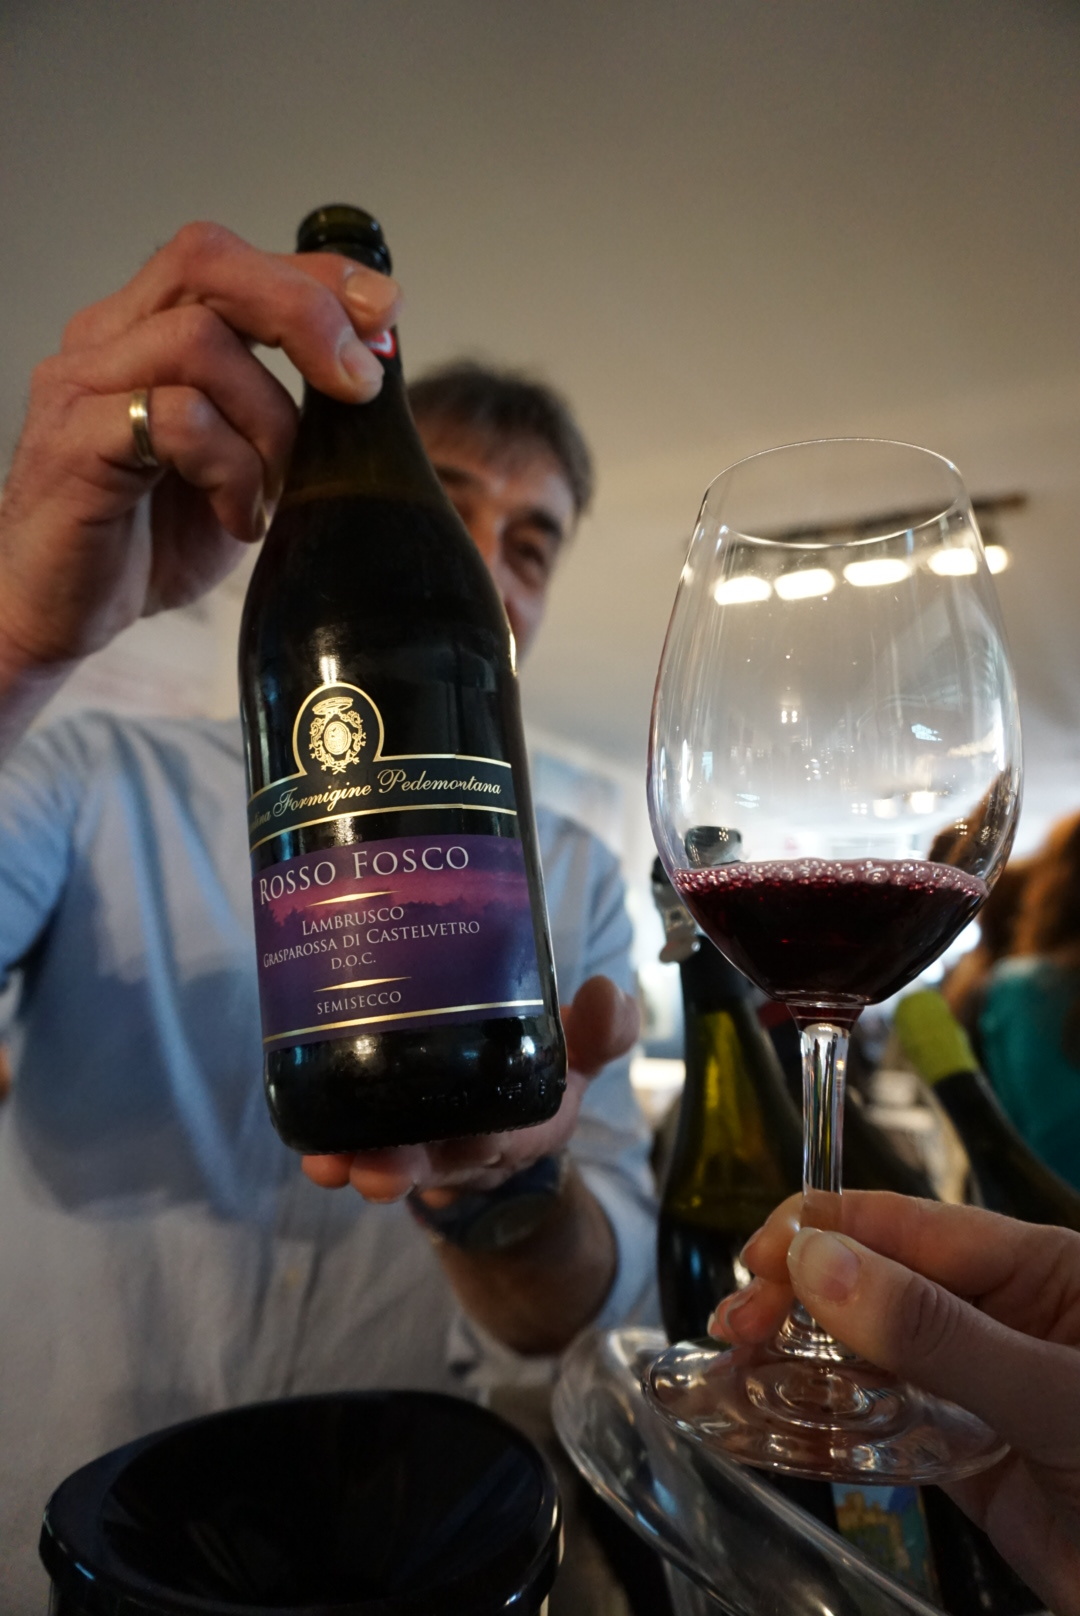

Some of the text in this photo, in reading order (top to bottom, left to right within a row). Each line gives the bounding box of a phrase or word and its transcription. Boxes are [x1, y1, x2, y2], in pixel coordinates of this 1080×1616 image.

[272, 781, 372, 818] Formigine
[377, 768, 502, 795] Pedemontana
[259, 846, 469, 905] ROSSO FOSCO
[302, 906, 404, 936] LAMBRUSCO
[263, 920, 480, 968] GRASPAROSSA DI CASTELVETRO
[331, 952, 377, 970] D.O.C.
[317, 990, 402, 1015] SEMISECCO
